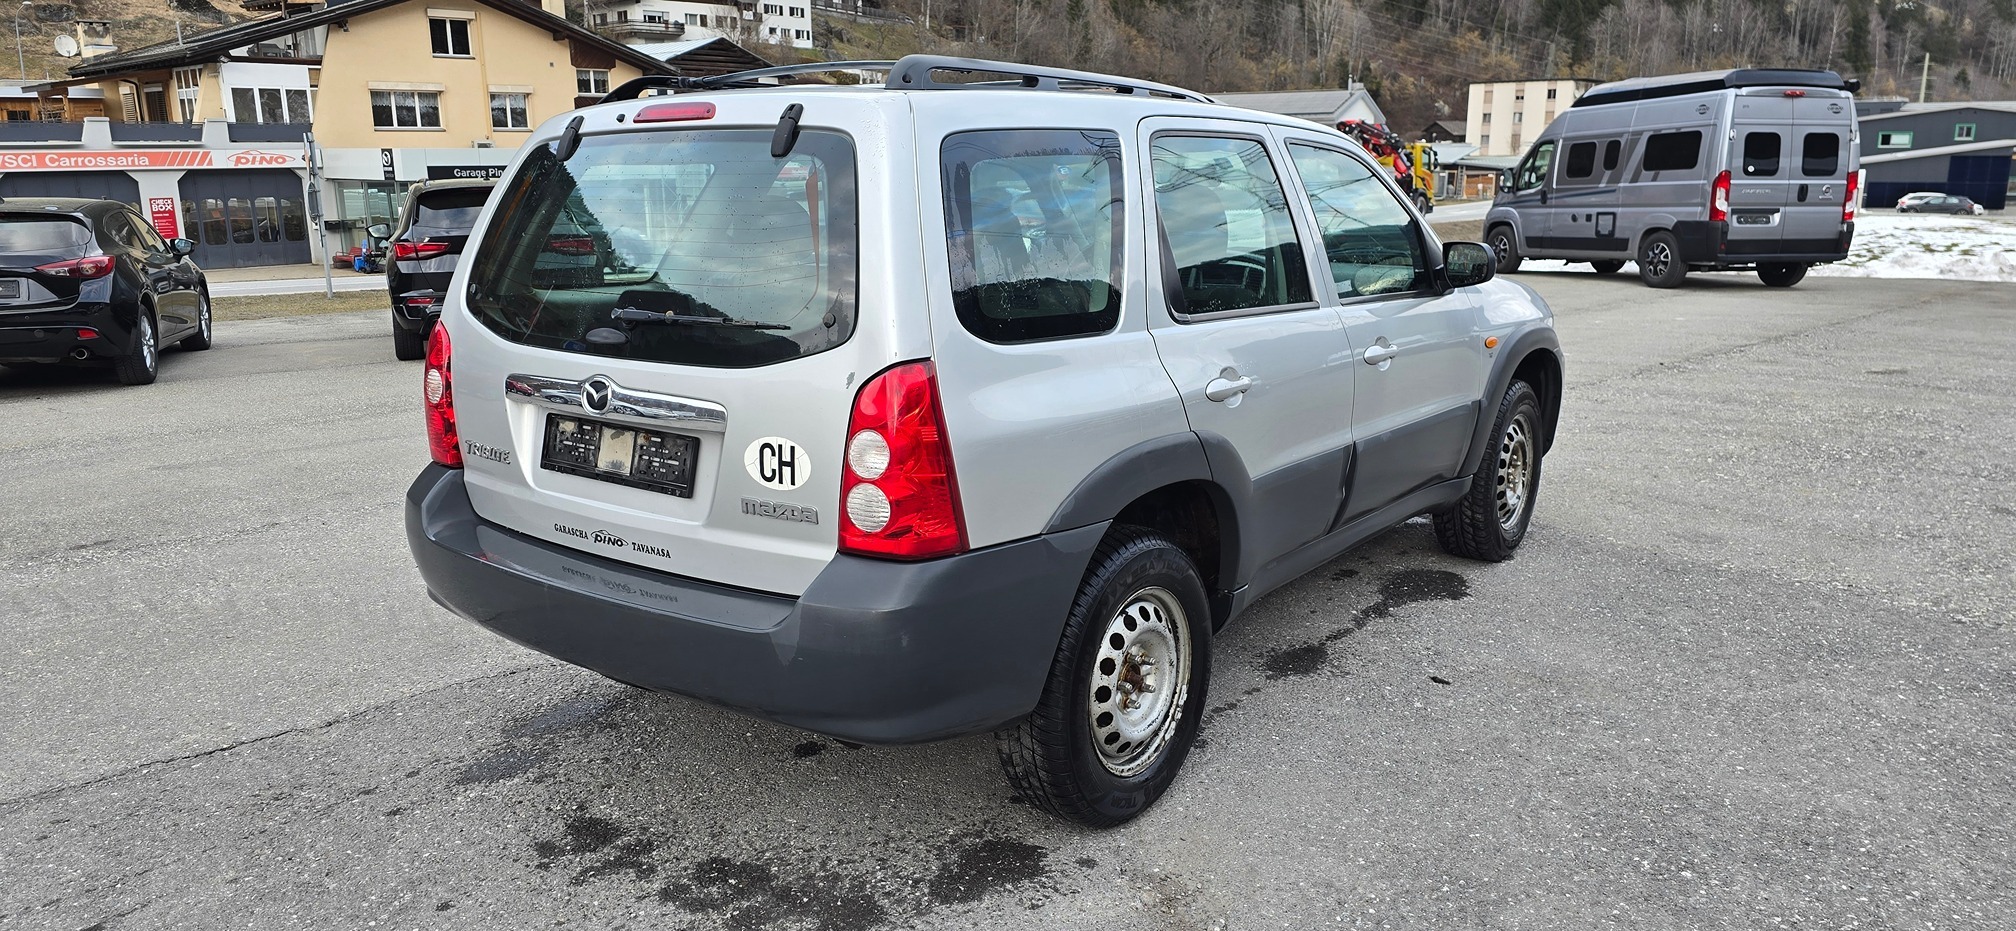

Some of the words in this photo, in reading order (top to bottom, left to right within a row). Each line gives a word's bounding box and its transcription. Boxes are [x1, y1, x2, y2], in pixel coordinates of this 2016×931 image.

[0, 154, 37, 168] SCI
[45, 154, 150, 167] Carrossaria
[453, 168, 487, 179] Garage
[488, 167, 504, 177] Pin
[152, 204, 173, 212] BOX
[465, 440, 511, 465] TRIBUTE
[759, 442, 796, 486] CH
[554, 523, 589, 540] GARASCHA
[631, 542, 671, 559] TAVANASA
